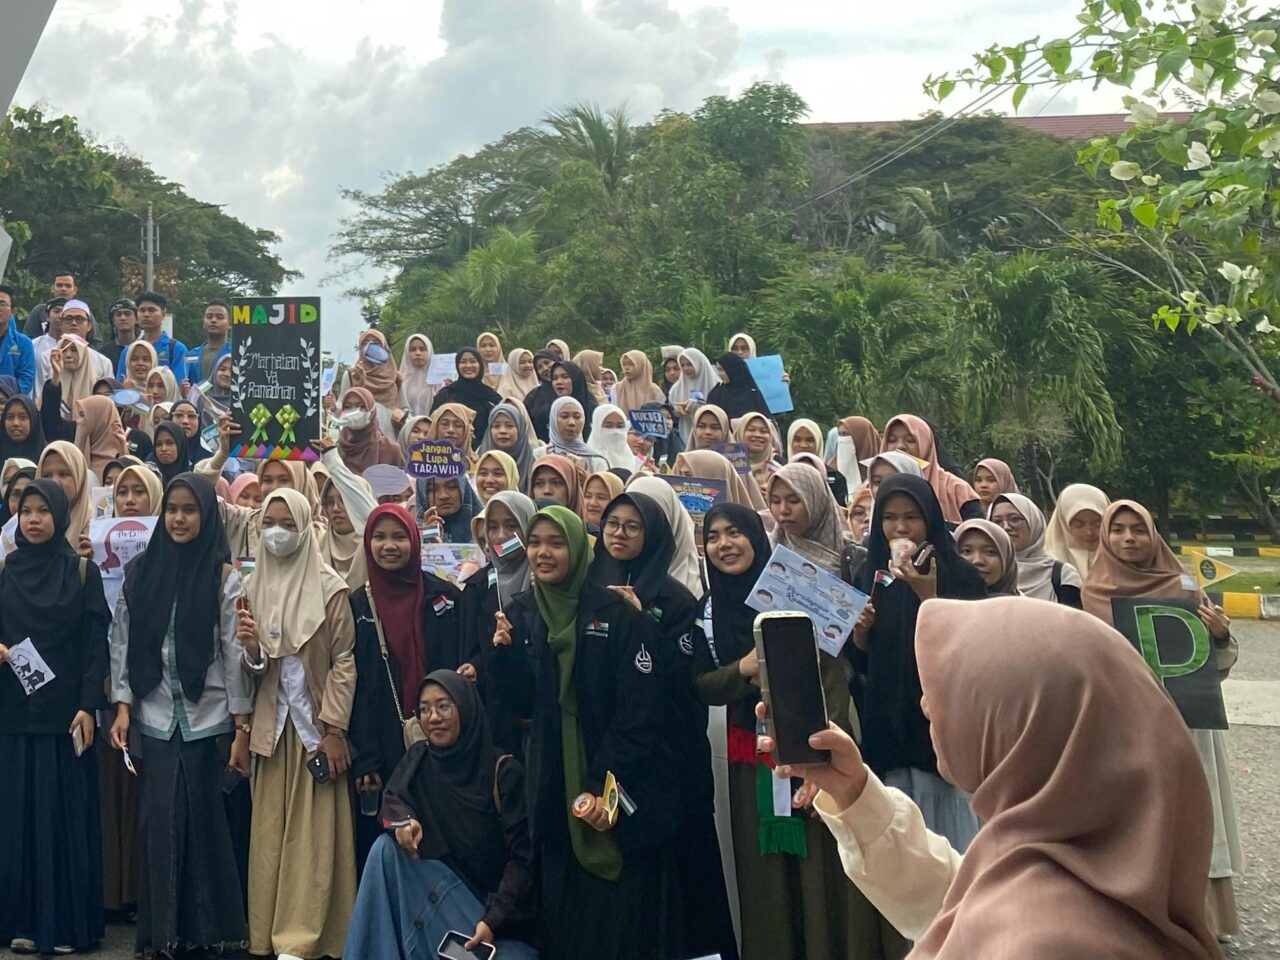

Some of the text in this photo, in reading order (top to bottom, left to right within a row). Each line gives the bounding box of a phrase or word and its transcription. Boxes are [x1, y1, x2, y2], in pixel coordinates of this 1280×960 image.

[233, 304, 317, 325] MAJID
[420, 443, 452, 454] Jangan
[426, 454, 448, 464] Lupa
[413, 463, 459, 475] TARAWIH
